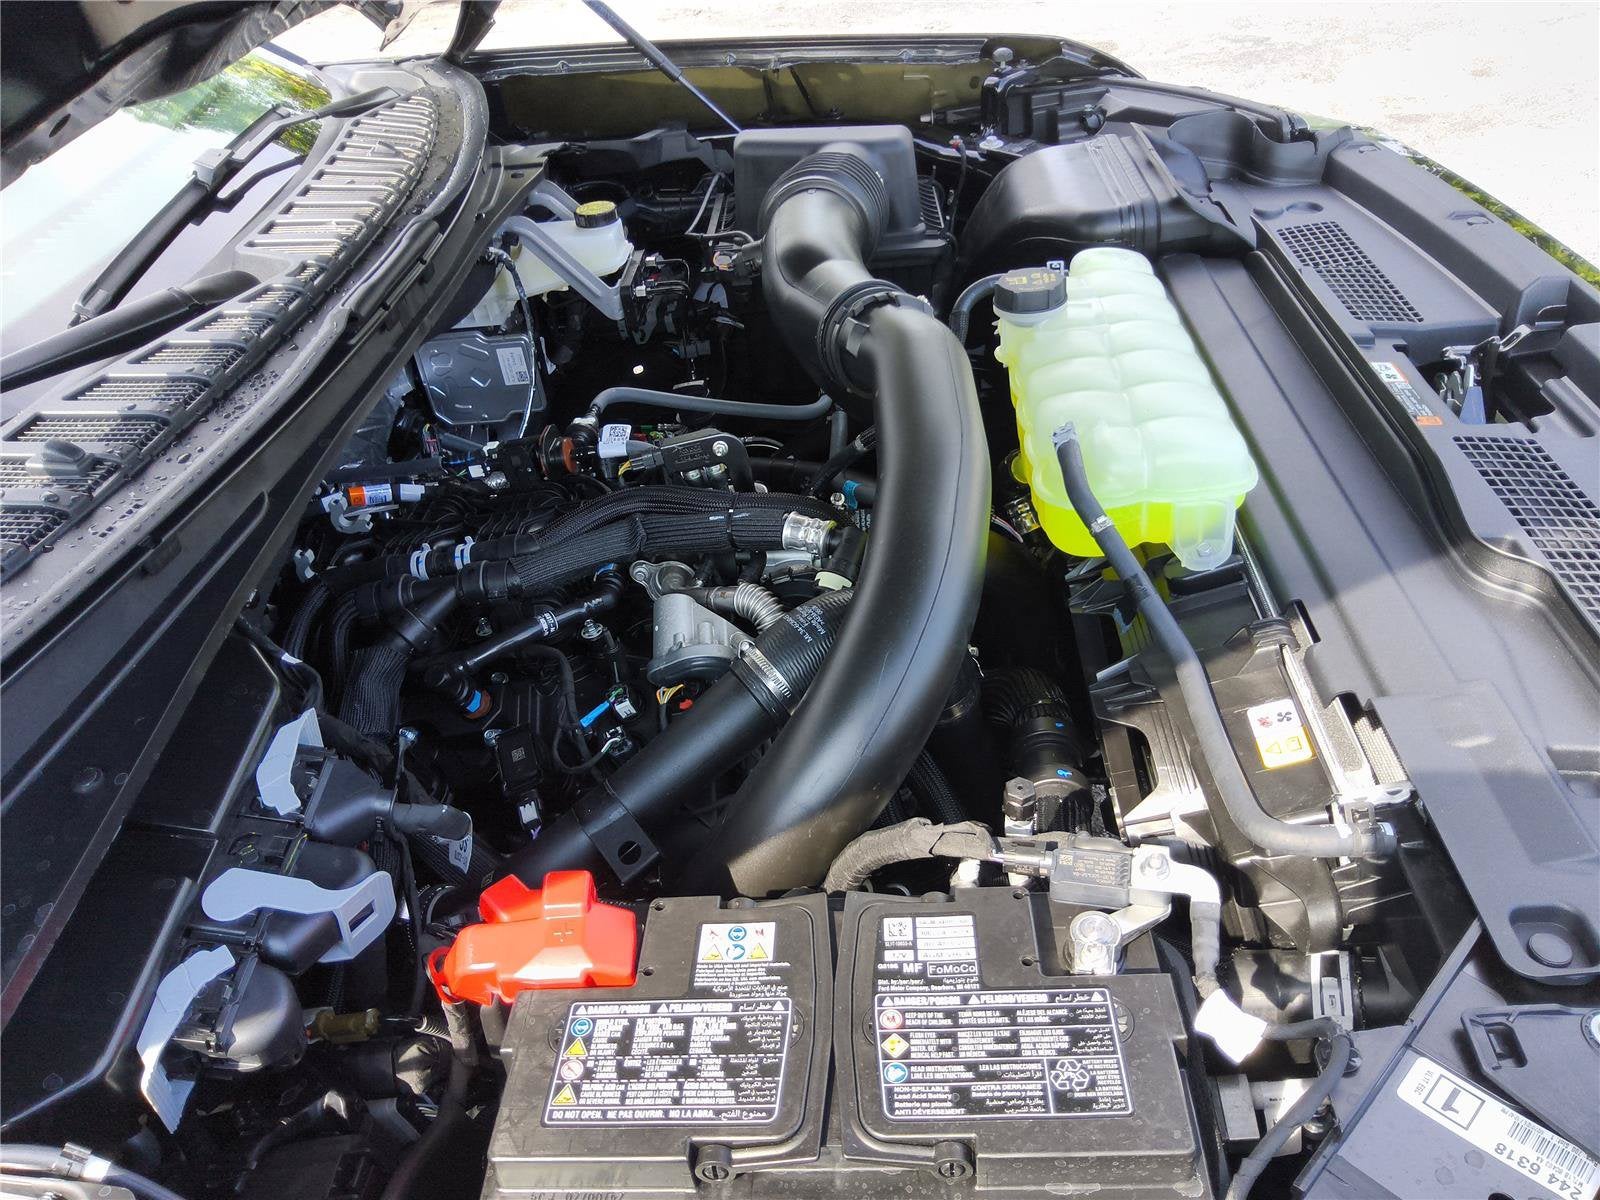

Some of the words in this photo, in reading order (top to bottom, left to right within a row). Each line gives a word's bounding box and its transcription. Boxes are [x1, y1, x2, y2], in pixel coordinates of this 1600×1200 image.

[903, 963, 923, 973] MF
[929, 964, 976, 974] FoMoCo
[1441, 1087, 1461, 1114] 1
[618, 1110, 633, 1118] PAS
[634, 1110, 665, 1118] OUVRIR.
[669, 1110, 681, 1118] NO
[682, 1110, 692, 1118] LA
[1494, 1142, 1541, 1176] 6318
[1546, 1172, 1583, 1200] 244
